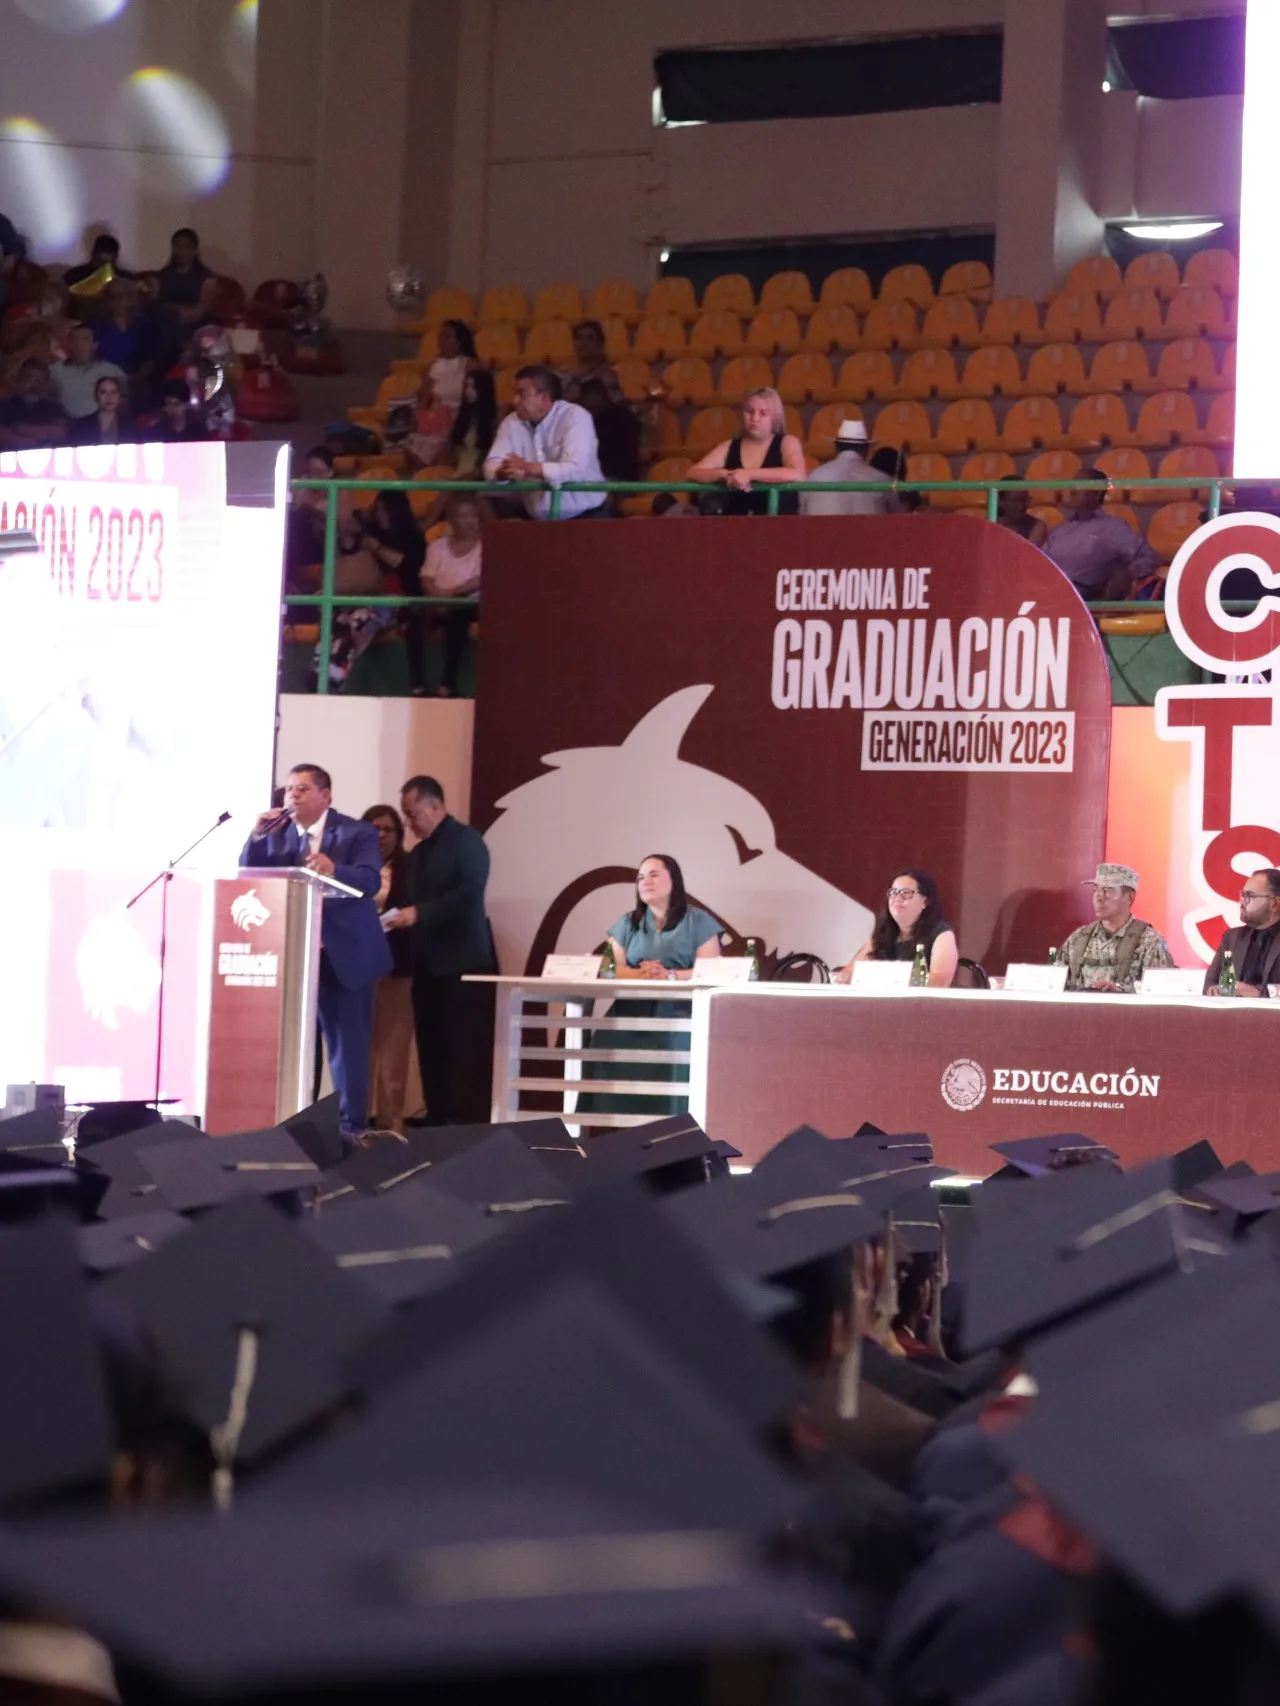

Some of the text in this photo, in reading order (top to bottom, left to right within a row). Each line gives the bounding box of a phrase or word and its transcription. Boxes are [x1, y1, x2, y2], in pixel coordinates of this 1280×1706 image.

[87, 505, 164, 602] 2023
[776, 568, 931, 611] CEREMONIA DE
[771, 601, 1070, 711] GRADUACIÓN
[869, 714, 1067, 764] GENERACIÓN 2023
[992, 1067, 1161, 1096] EDUCACIÓN
[992, 1097, 1036, 1106] SECRETARÍA
[1049, 1100, 1091, 1108] EDUCACIÓN
[1093, 1101, 1125, 1109] PÚBLICA
